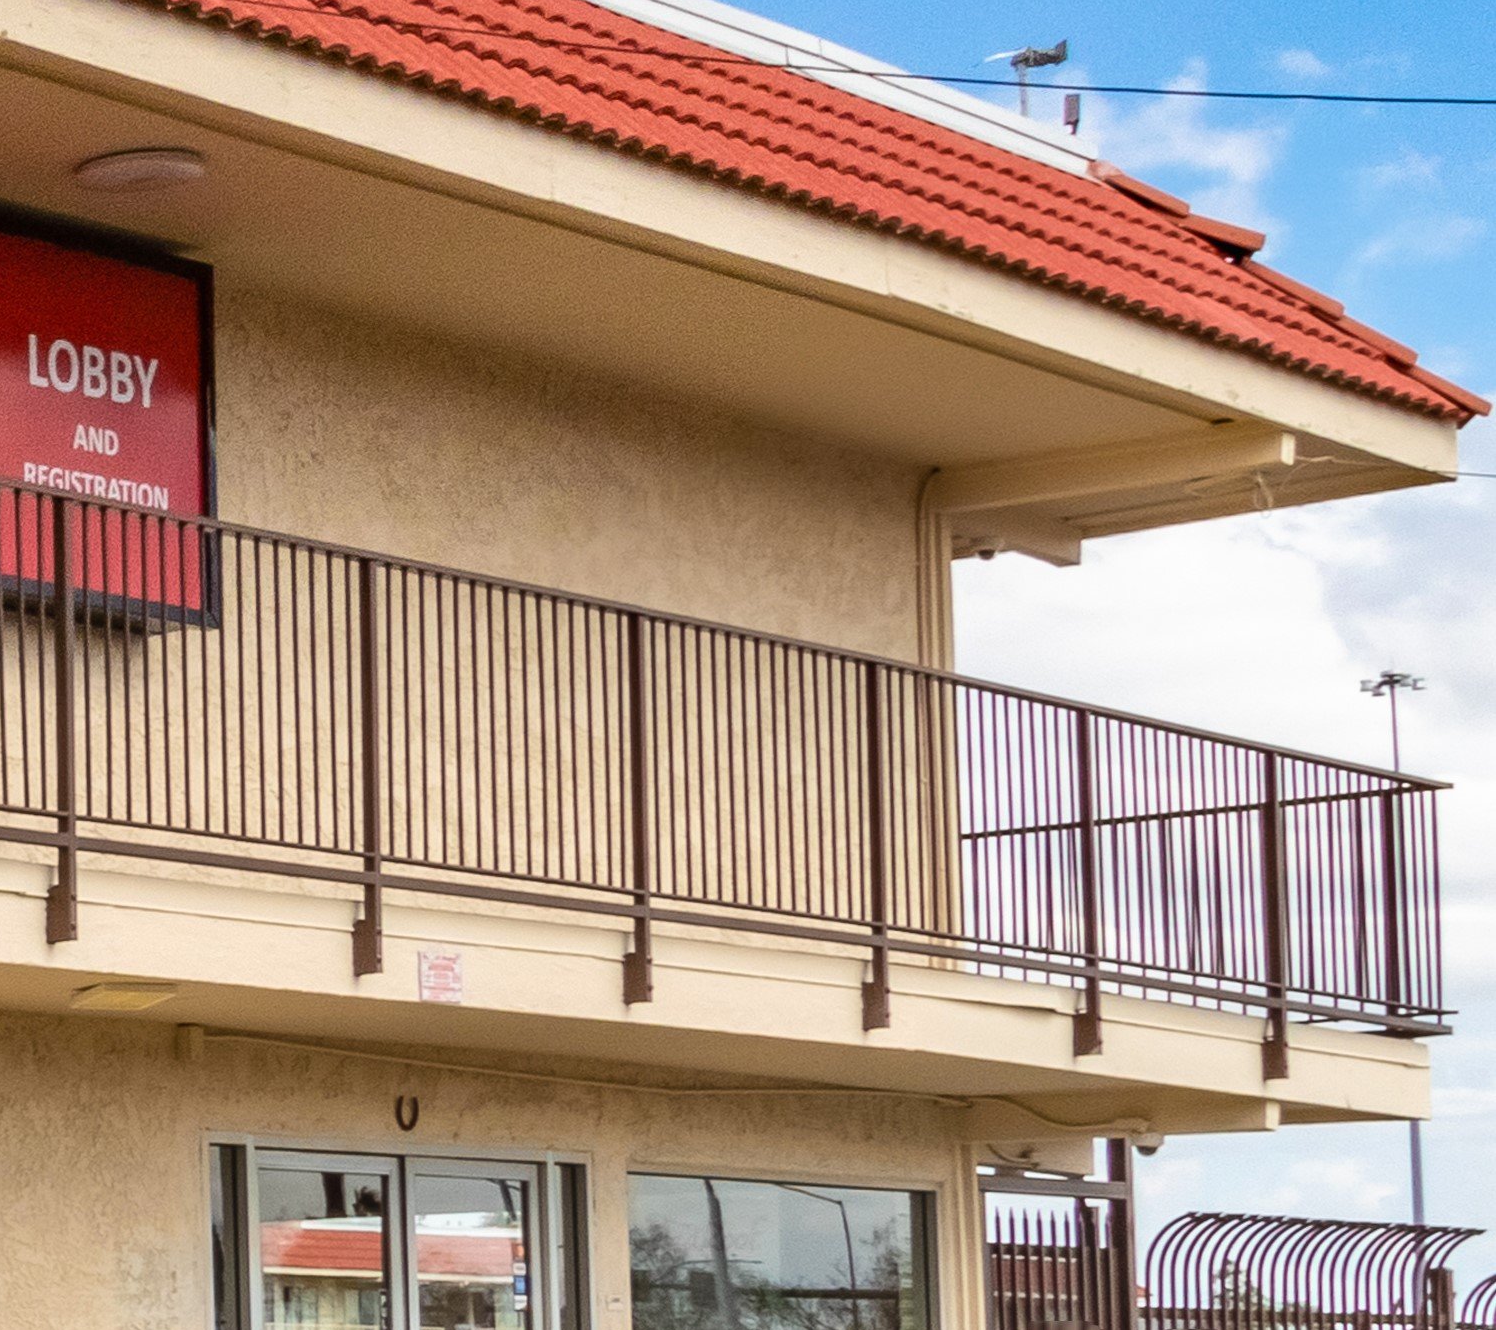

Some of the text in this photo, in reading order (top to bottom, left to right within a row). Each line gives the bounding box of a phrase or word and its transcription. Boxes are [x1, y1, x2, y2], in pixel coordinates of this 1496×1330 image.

[28, 333, 159, 409] LOBBY
[72, 423, 120, 457] AND
[23, 461, 170, 511] REGISTRATION
